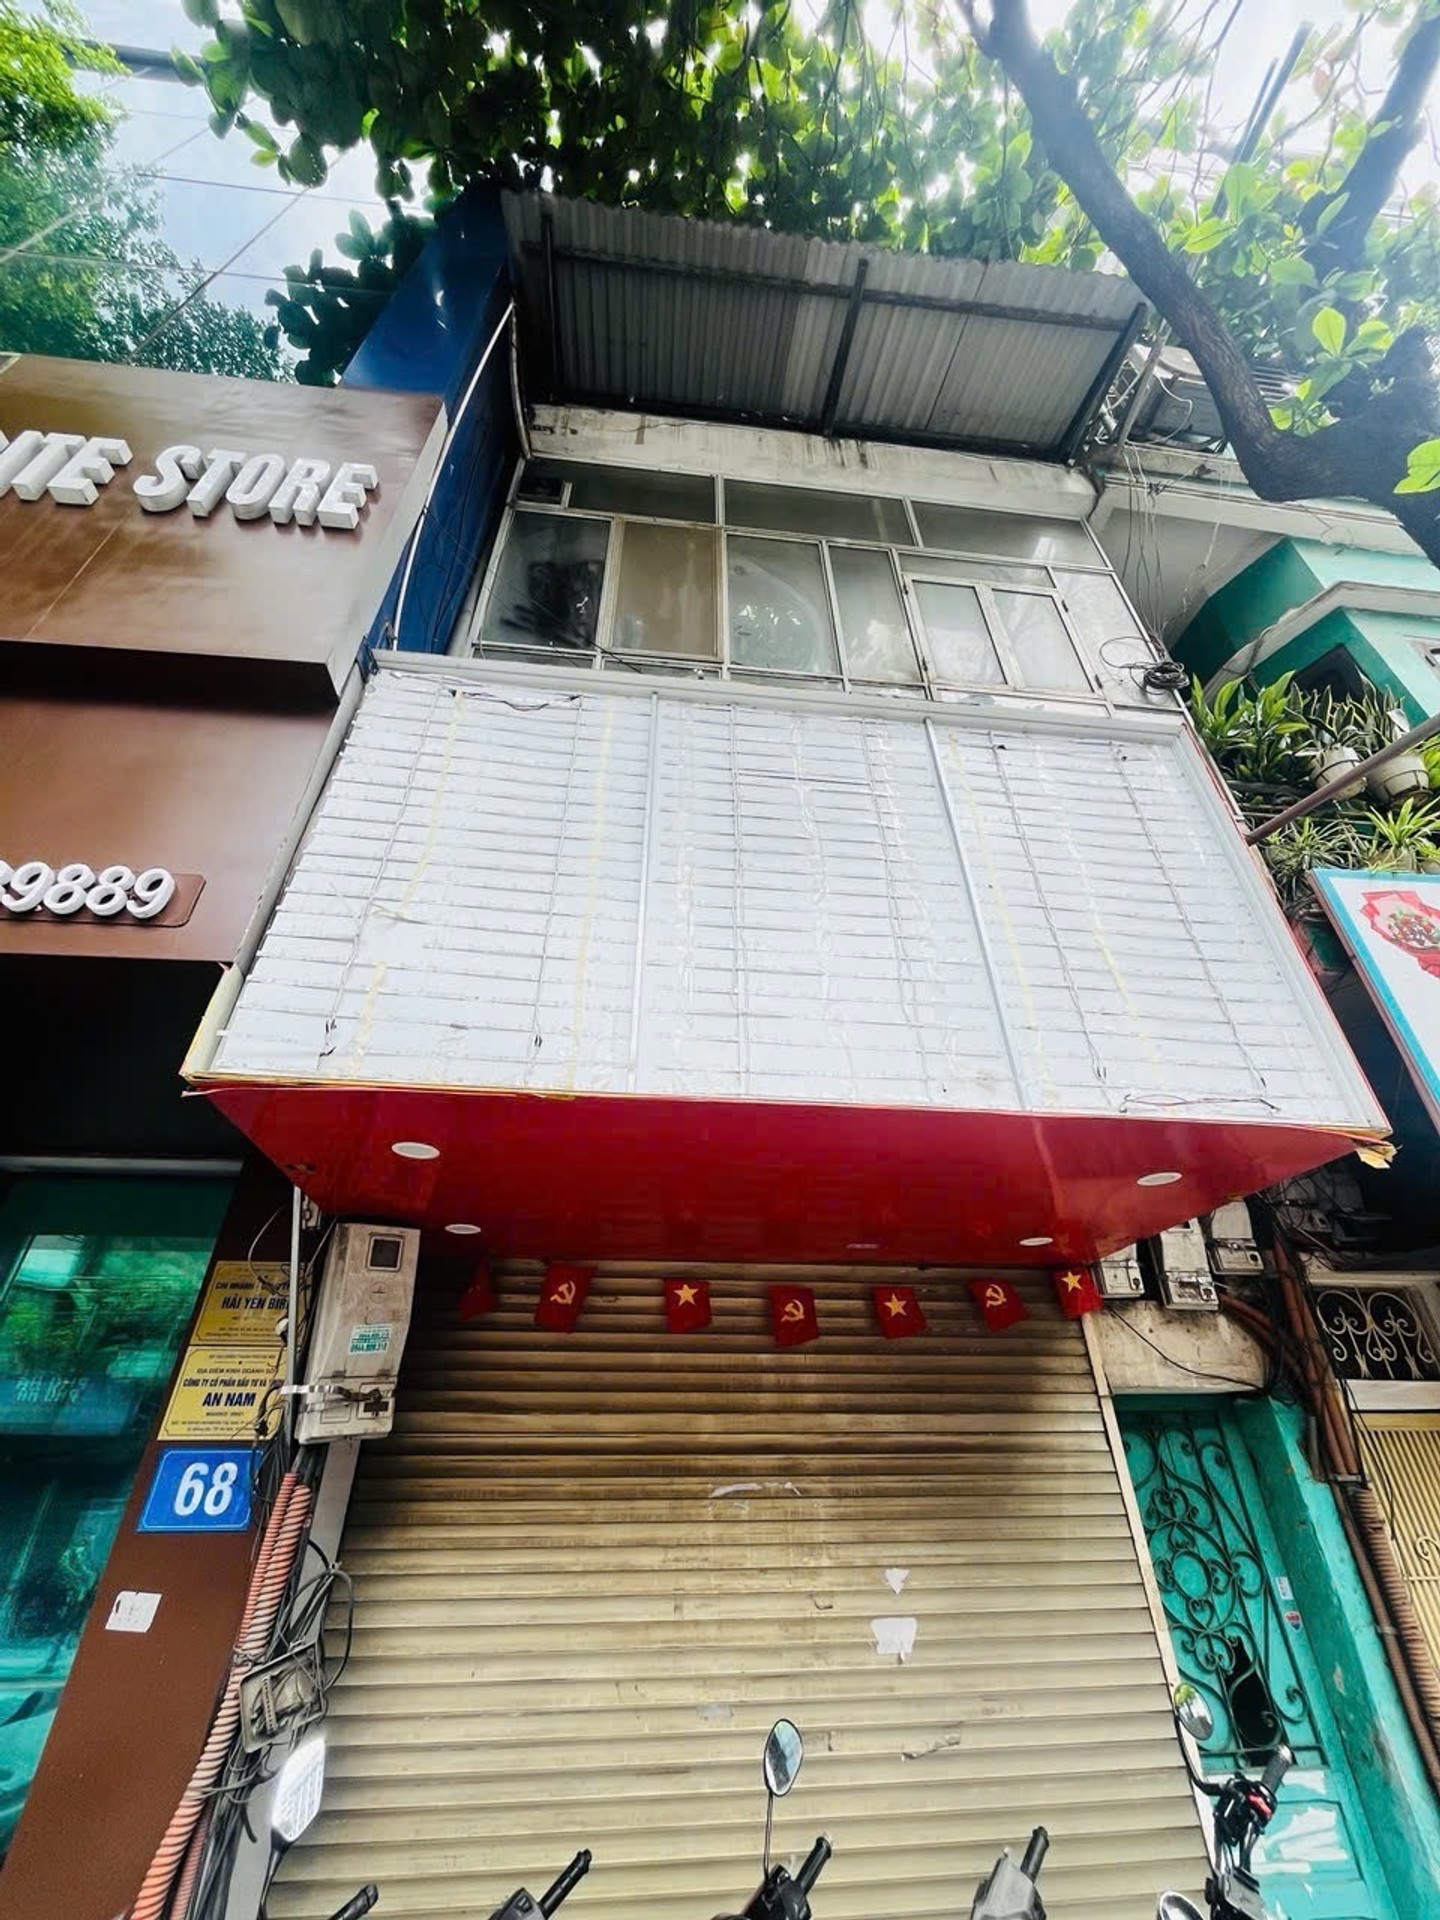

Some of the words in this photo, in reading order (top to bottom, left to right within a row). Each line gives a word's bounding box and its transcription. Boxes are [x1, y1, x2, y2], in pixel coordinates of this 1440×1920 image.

[0, 430, 133, 505] ITE
[133, 445, 379, 529] STORE
[183, 1378, 200, 1387] CÔNG
[201, 1379, 209, 1387] TY
[202, 1392, 223, 1406] AN
[224, 1392, 256, 1406] NAM
[174, 1462, 238, 1516] 68
